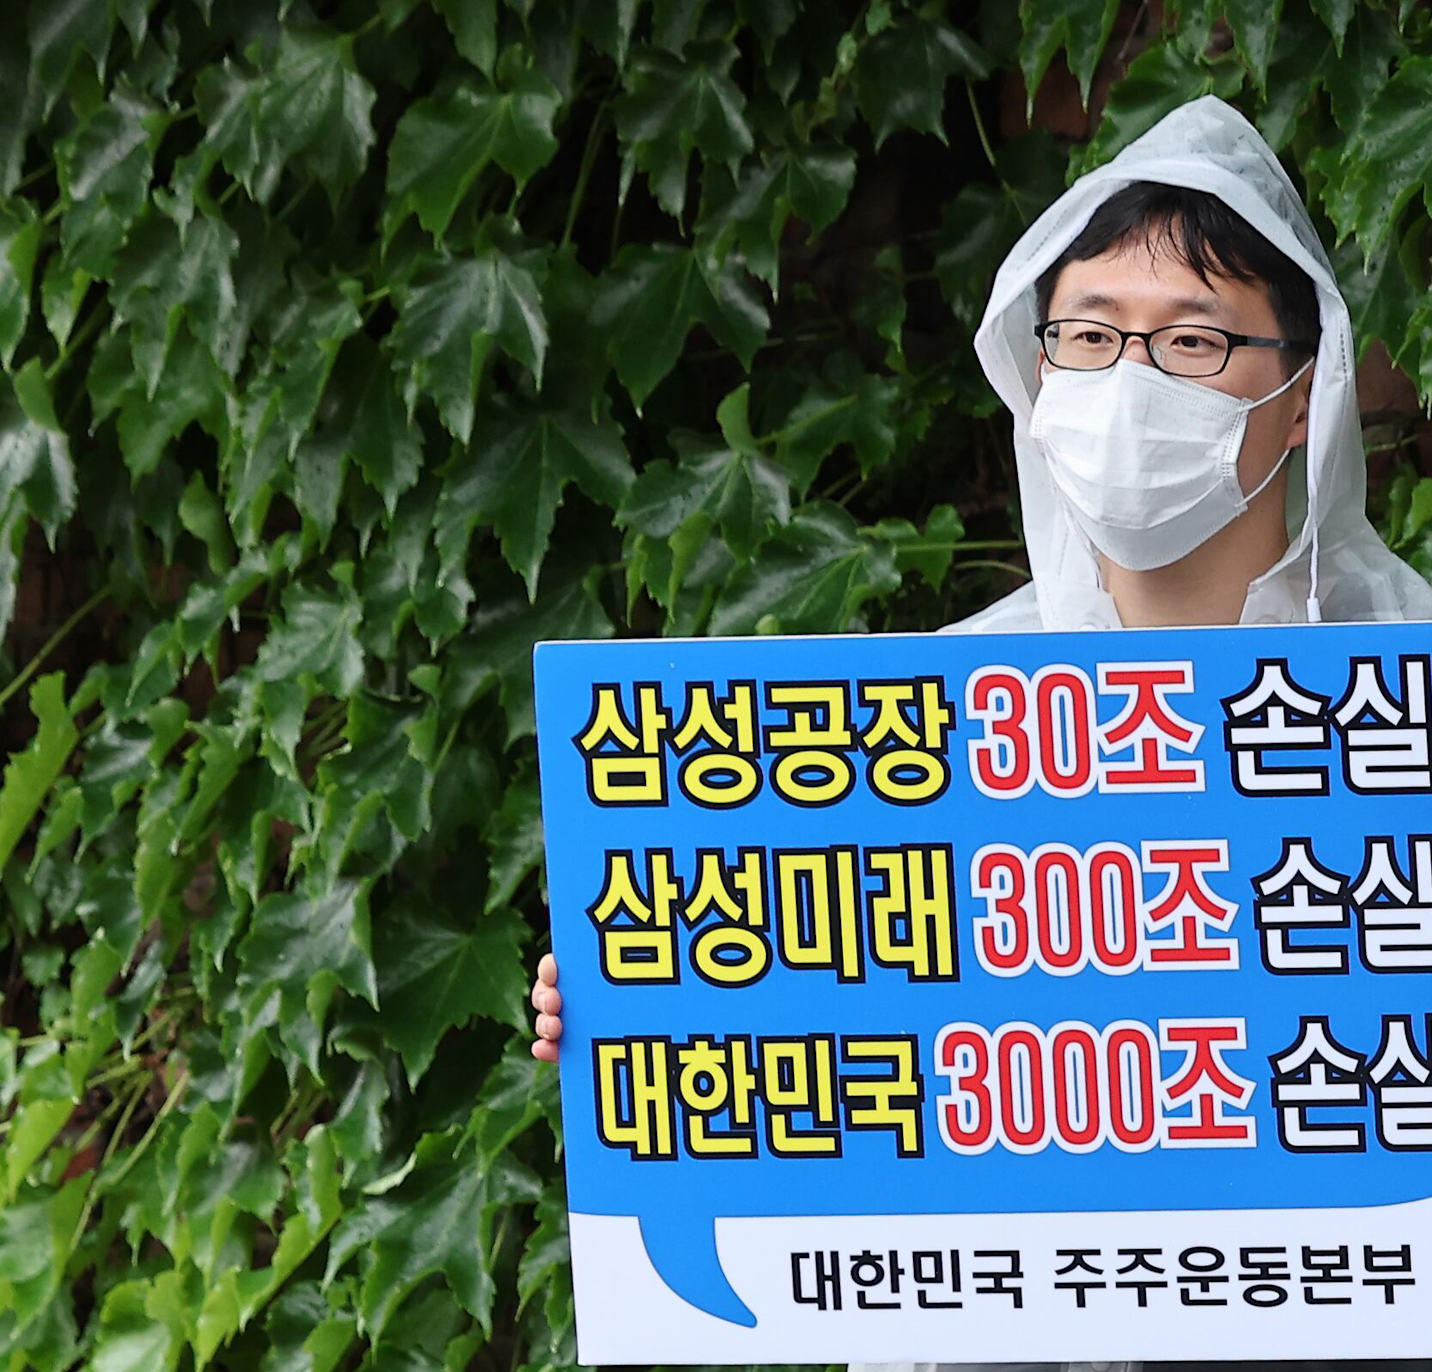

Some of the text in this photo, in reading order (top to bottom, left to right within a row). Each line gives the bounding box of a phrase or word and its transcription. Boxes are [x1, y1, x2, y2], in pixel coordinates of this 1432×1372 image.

[572, 674, 956, 808] 삼성공장
[964, 659, 1206, 799] 30조
[588, 842, 960, 986] 삼성미래
[971, 838, 1240, 978] 300조
[592, 1032, 925, 1161] 대한민국
[932, 1017, 1257, 1156] 3000조
[790, 1244, 1416, 1312] 대한민국 주주운동본부
